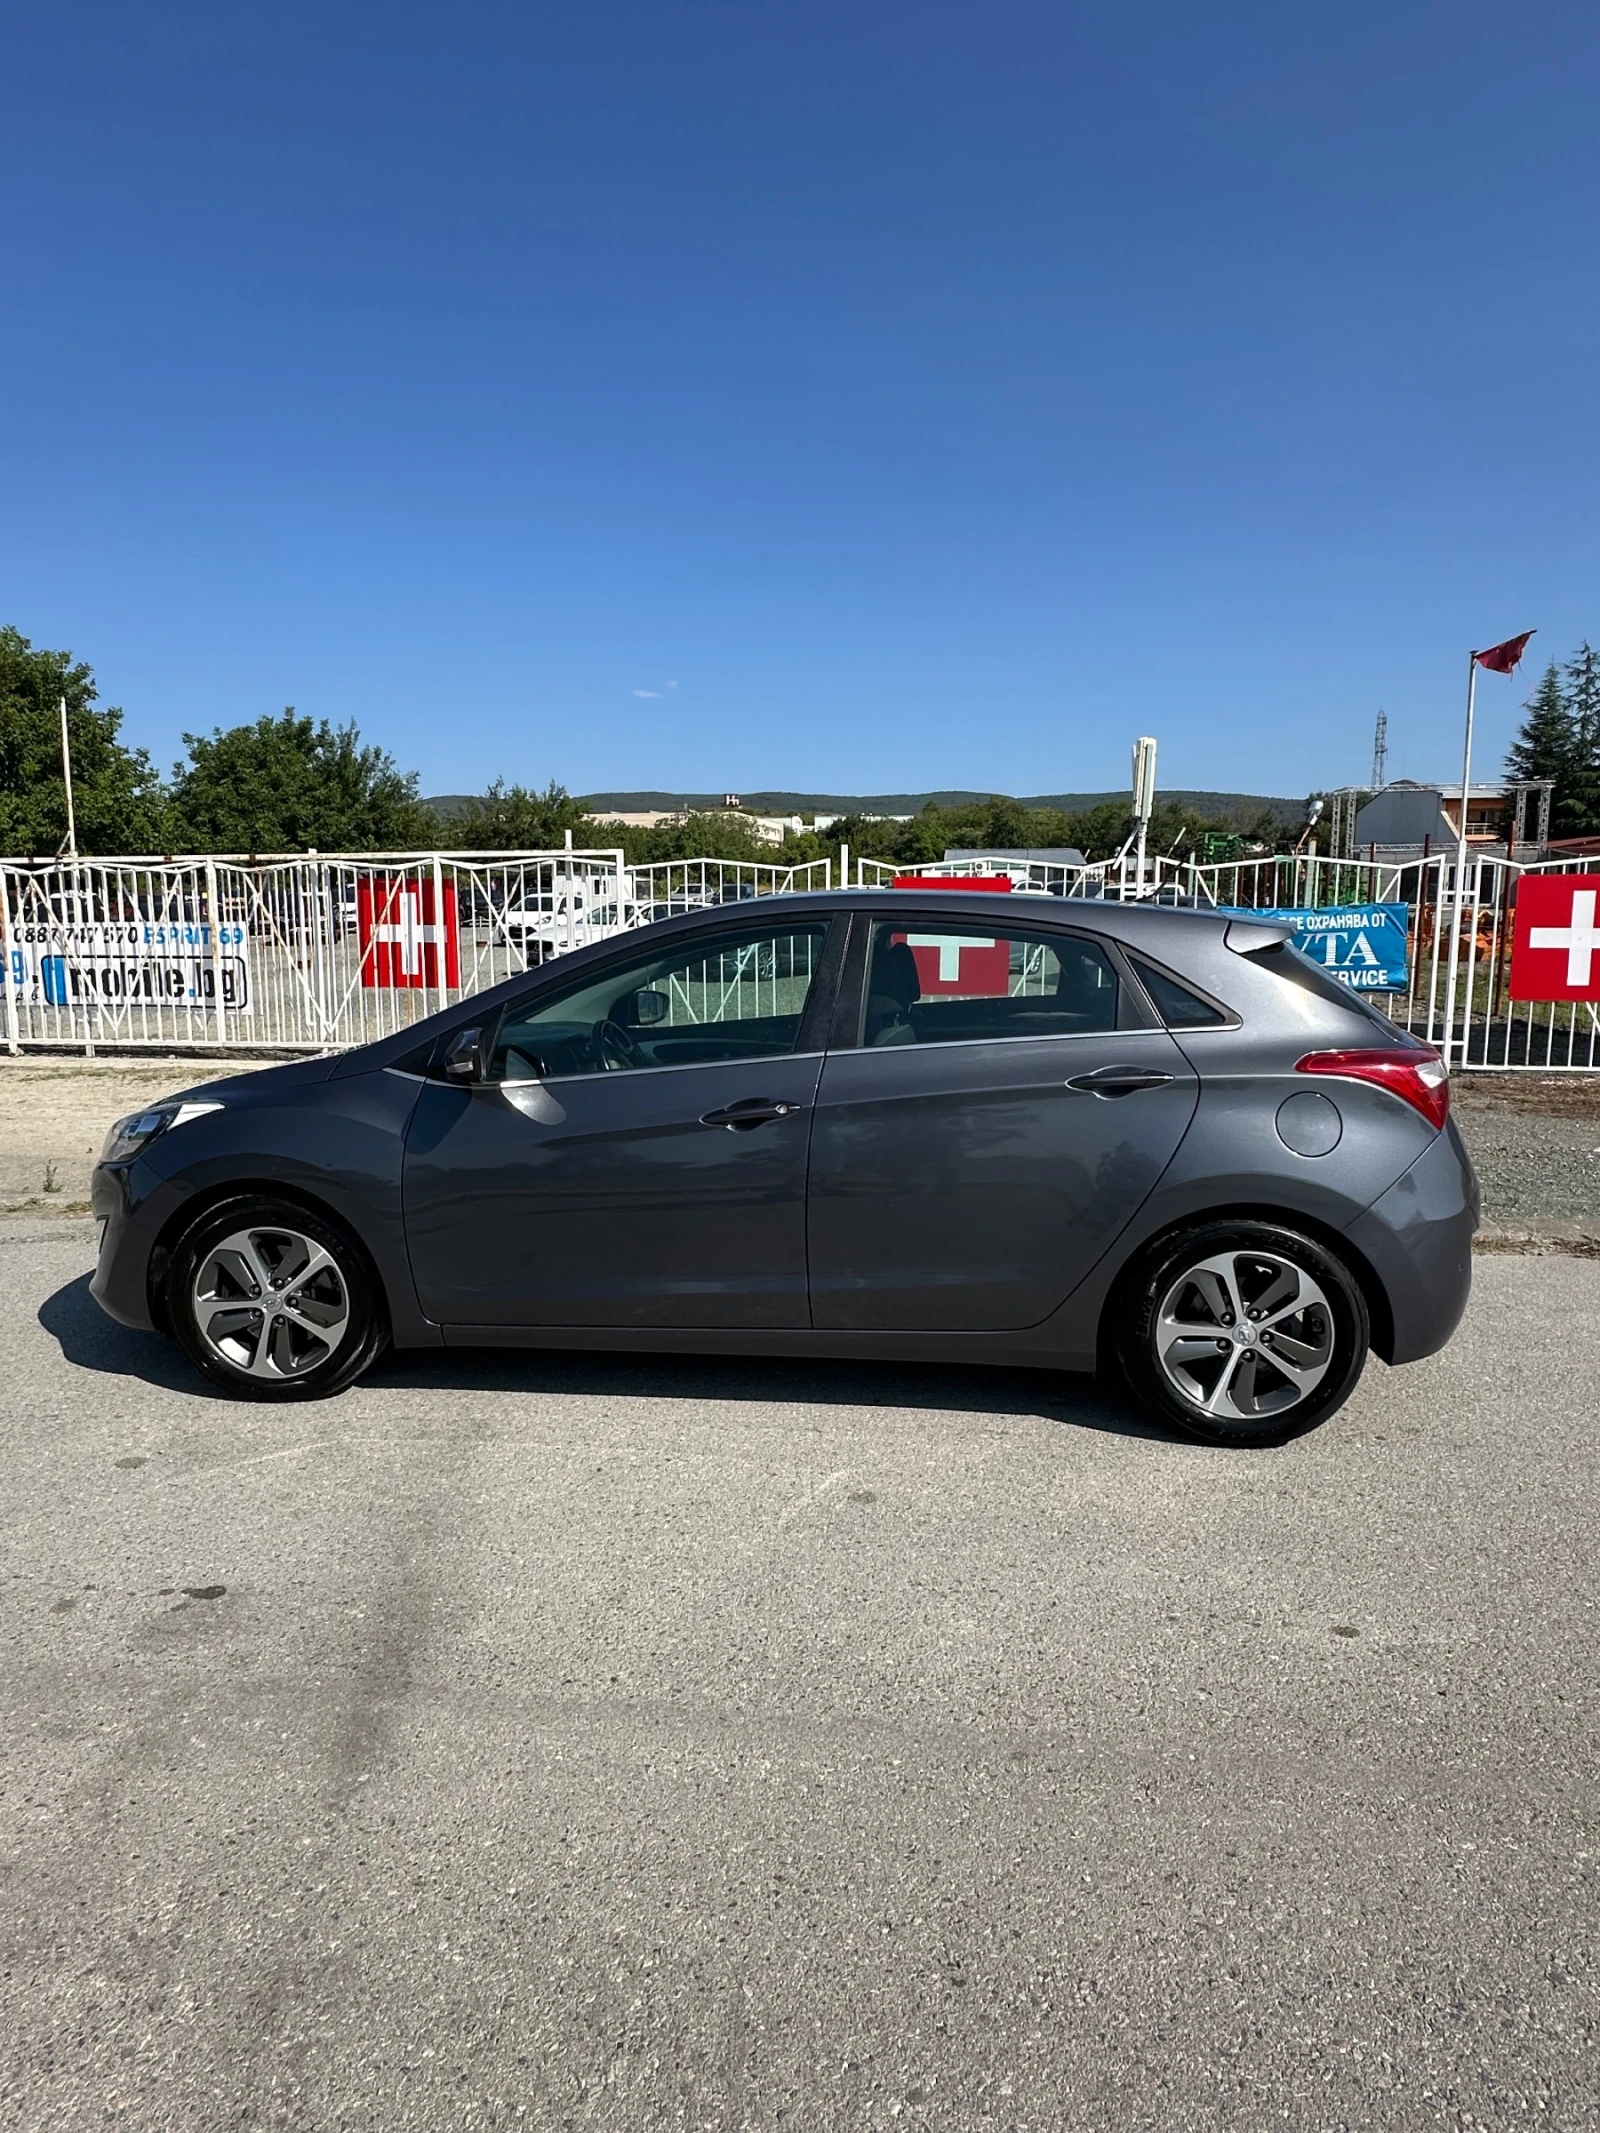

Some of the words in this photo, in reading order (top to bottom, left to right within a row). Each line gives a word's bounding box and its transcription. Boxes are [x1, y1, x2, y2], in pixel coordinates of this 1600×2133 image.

[1306, 914, 1370, 929] ОХРАНЯВА
[1373, 913, 1387, 928] ОТ
[219, 927, 244, 944] 69
